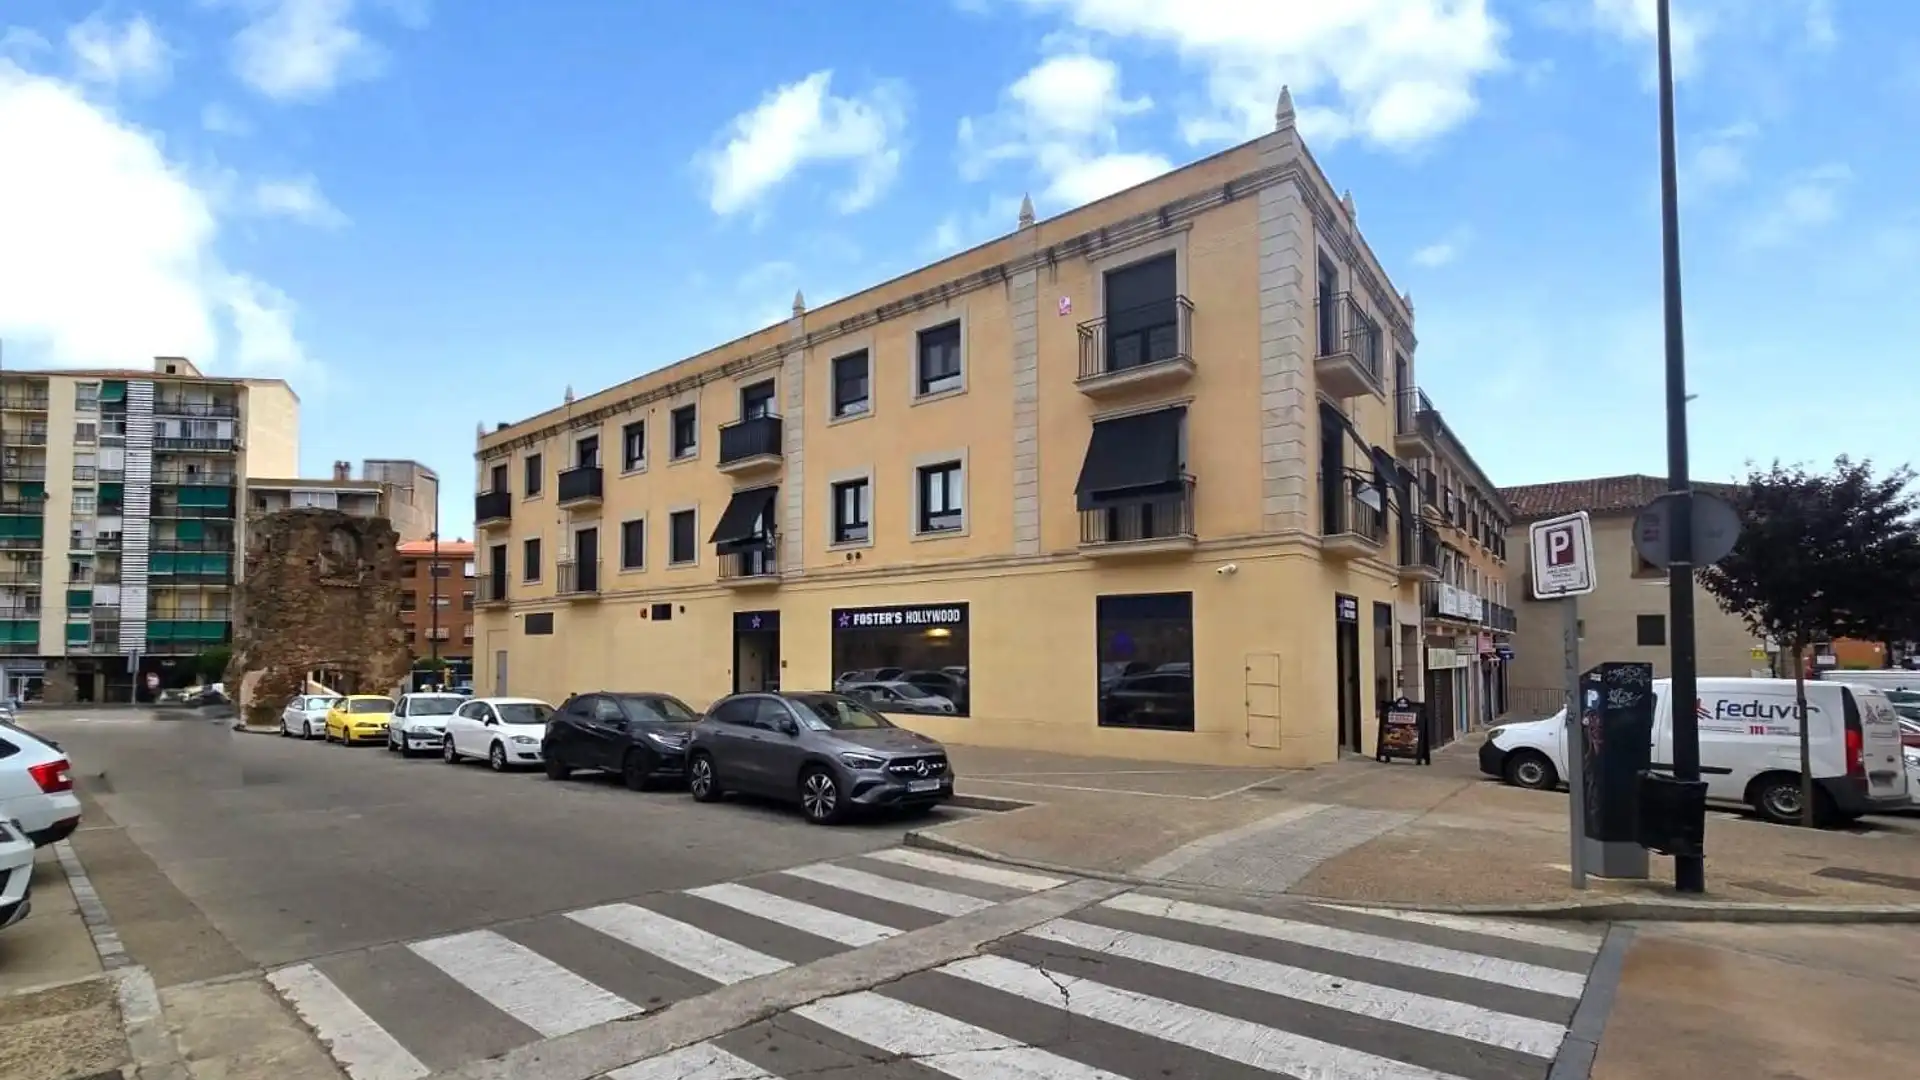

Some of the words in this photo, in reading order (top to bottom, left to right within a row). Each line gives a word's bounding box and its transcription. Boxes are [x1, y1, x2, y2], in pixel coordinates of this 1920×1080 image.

[1550, 530, 1569, 564] P
[853, 612, 902, 626] FOSTER'S
[905, 608, 961, 624] HOLLYWOOD
[1587, 689, 1600, 708] P
